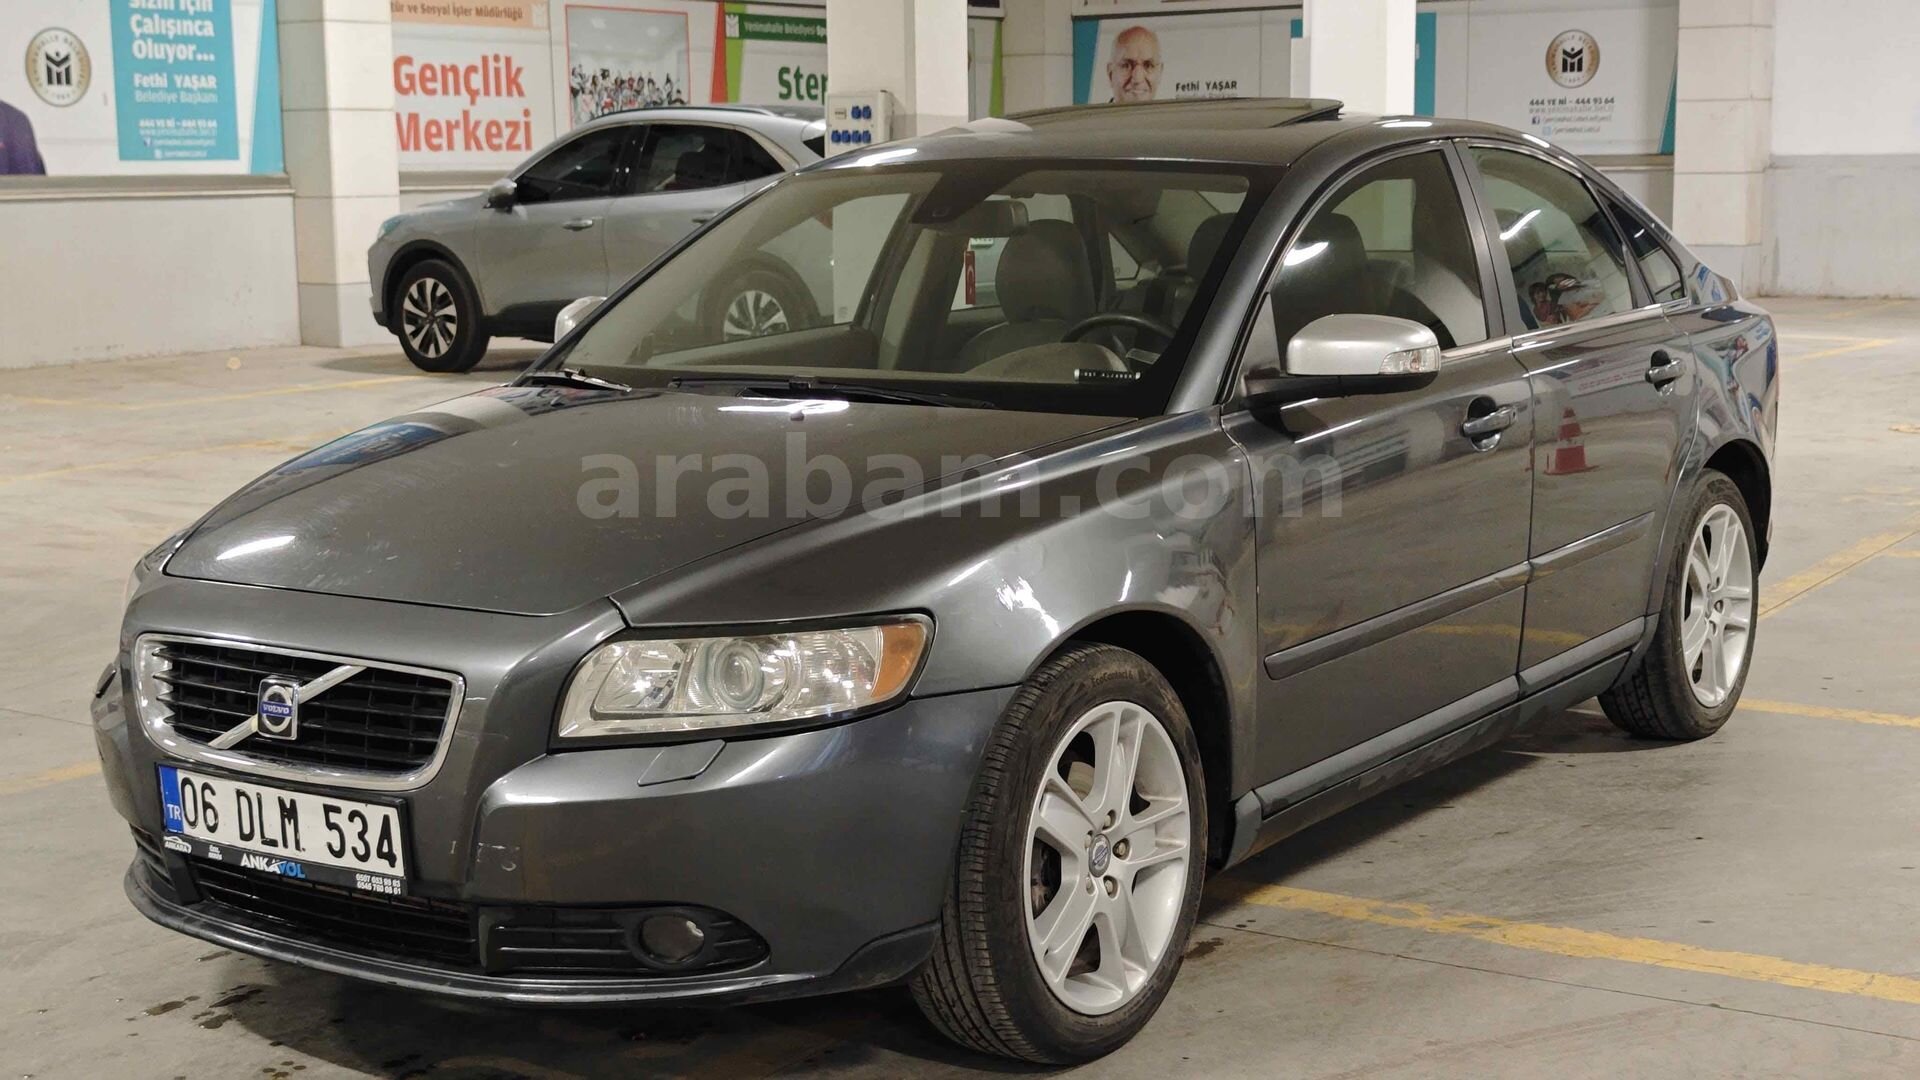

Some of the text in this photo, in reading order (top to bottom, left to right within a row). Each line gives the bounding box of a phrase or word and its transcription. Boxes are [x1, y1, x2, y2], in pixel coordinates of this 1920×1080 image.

[130, 13, 215, 39] Çalışınca
[132, 38, 216, 64] Oluyor...
[134, 72, 217, 91] Fethi YAŞAR
[393, 53, 526, 106] Gençlik
[1175, 80, 1238, 92] Fethi YAŞAR
[395, 108, 533, 152] Merkezi
[263, 703, 290, 714] VOLVO
[167, 803, 181, 820] TR
[181, 776, 398, 868] 06 DLM 534
[241, 852, 306, 879] ANKAVOL
